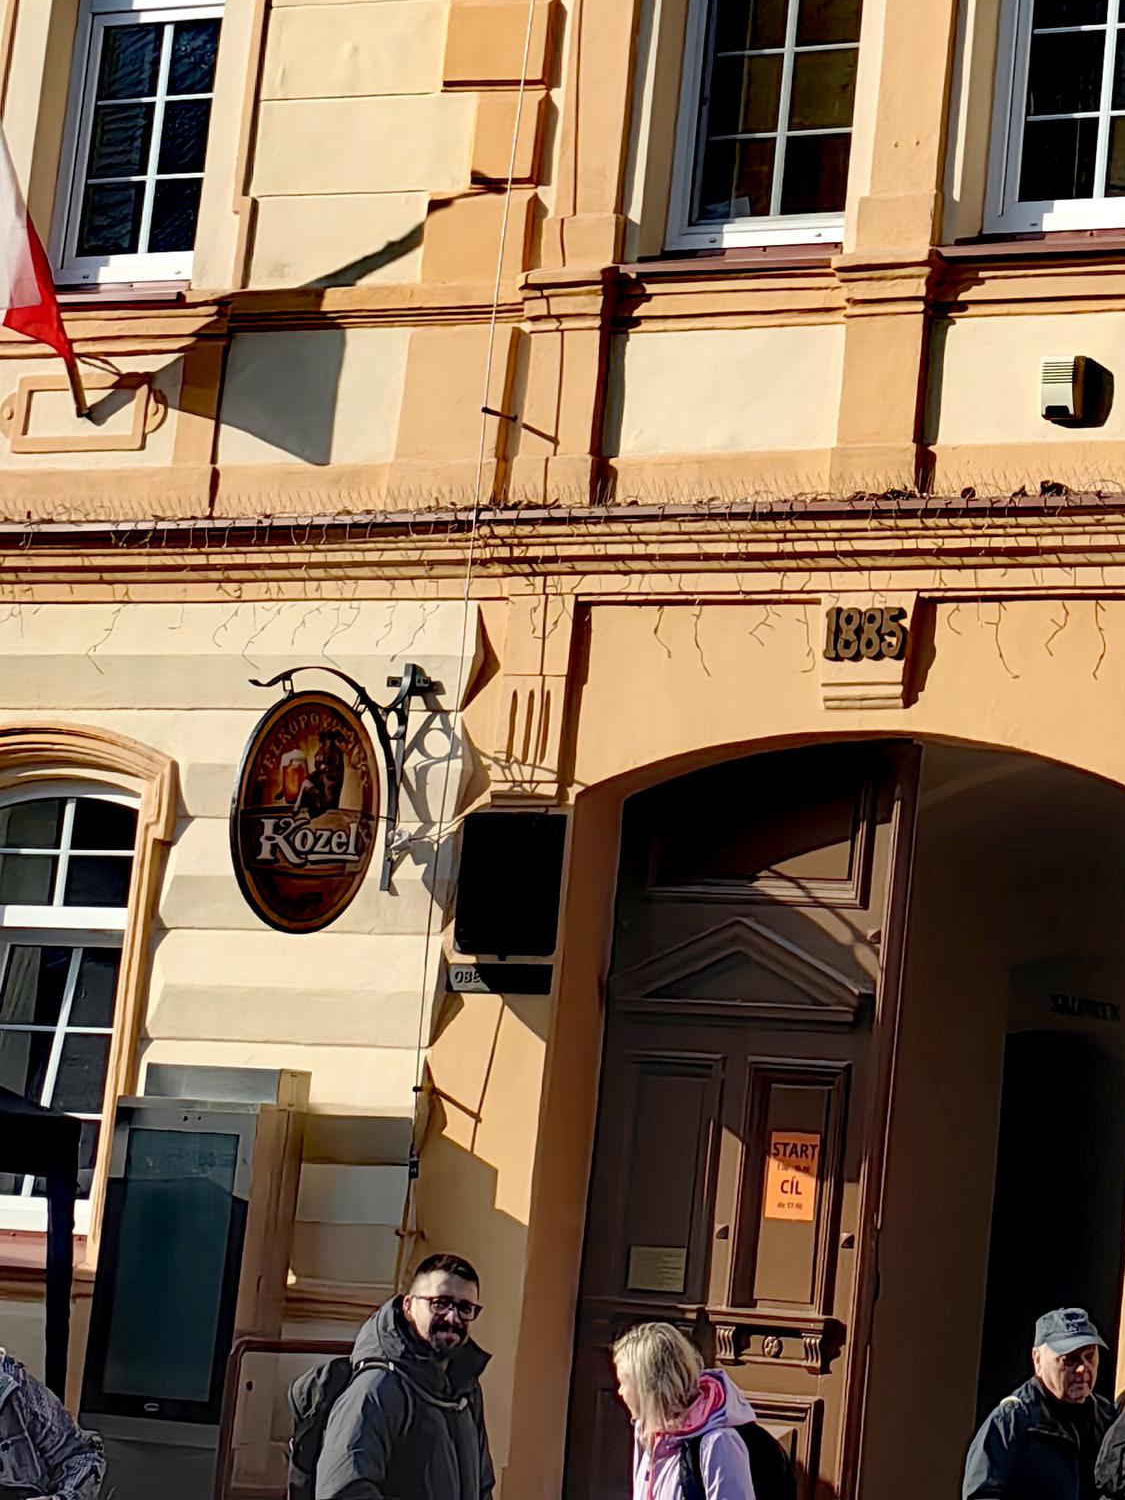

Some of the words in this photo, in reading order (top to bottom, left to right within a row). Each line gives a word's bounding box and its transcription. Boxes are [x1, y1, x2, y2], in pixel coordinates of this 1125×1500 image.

[823, 606, 906, 661] 1885
[256, 817, 358, 867] Kozel
[773, 1141, 819, 1160] START
[780, 1175, 803, 1196] CÍL
